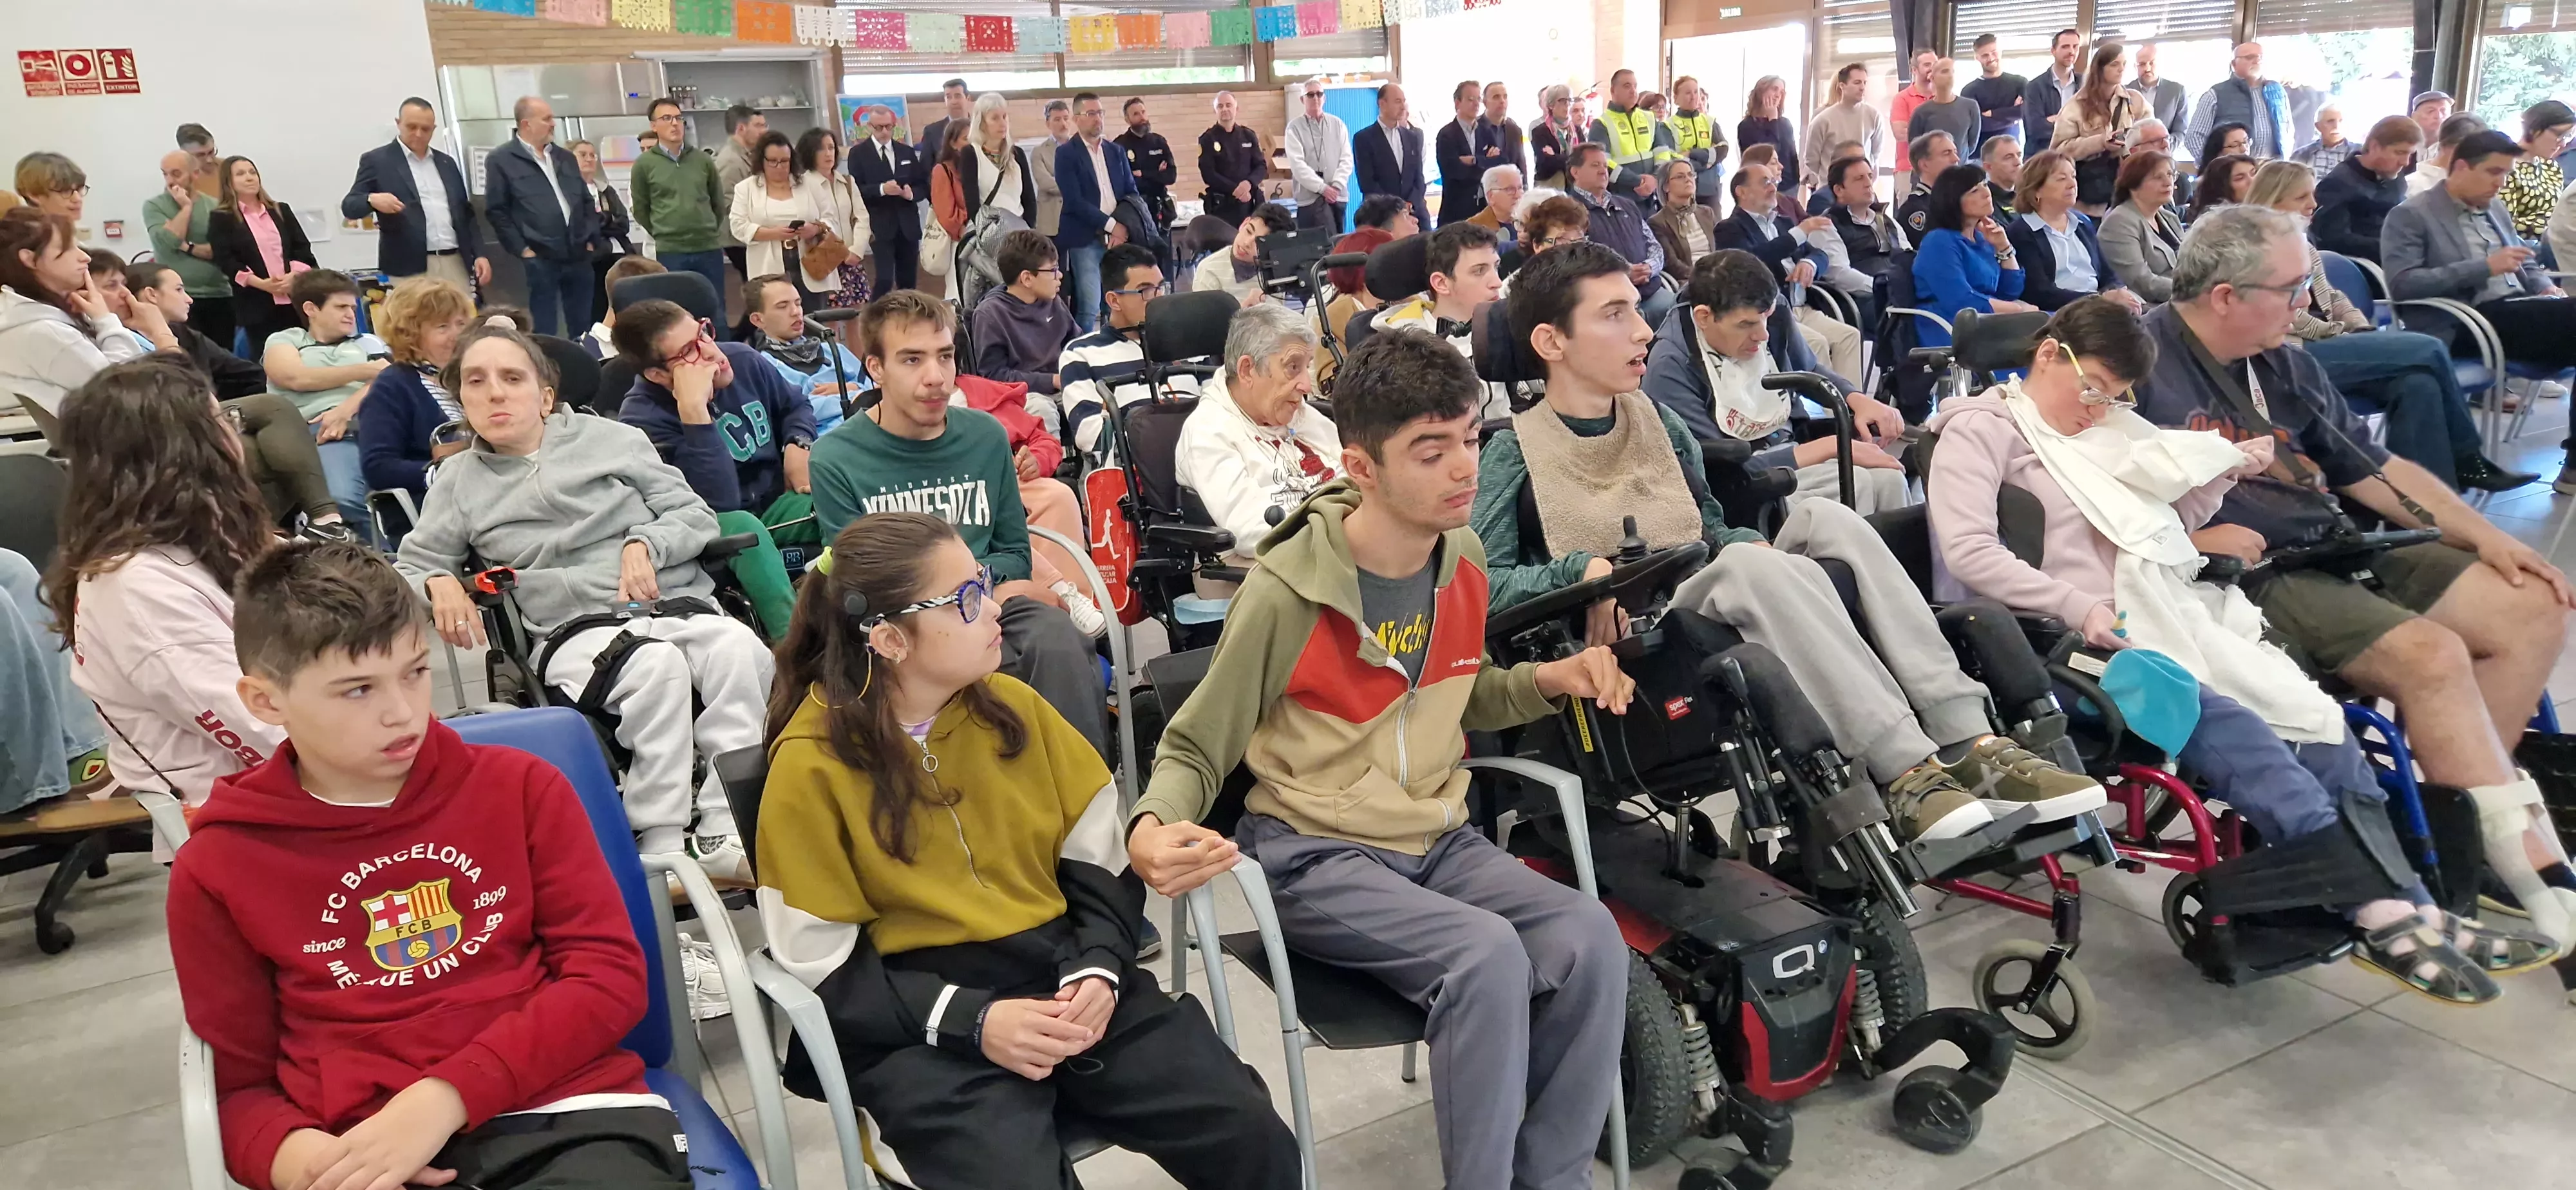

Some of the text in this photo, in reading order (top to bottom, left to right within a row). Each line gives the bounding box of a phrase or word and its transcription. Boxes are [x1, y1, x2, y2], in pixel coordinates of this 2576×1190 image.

[880, 474, 971, 493] MIDWEST
[862, 480, 990, 527] MINNESOTA
[321, 842, 483, 924] FC BARCELONA
[472, 885, 507, 910] 1899
[302, 936, 346, 954] since
[327, 959, 362, 990] MÉ
[423, 952, 460, 979] UN
[461, 912, 504, 956] CLUB
